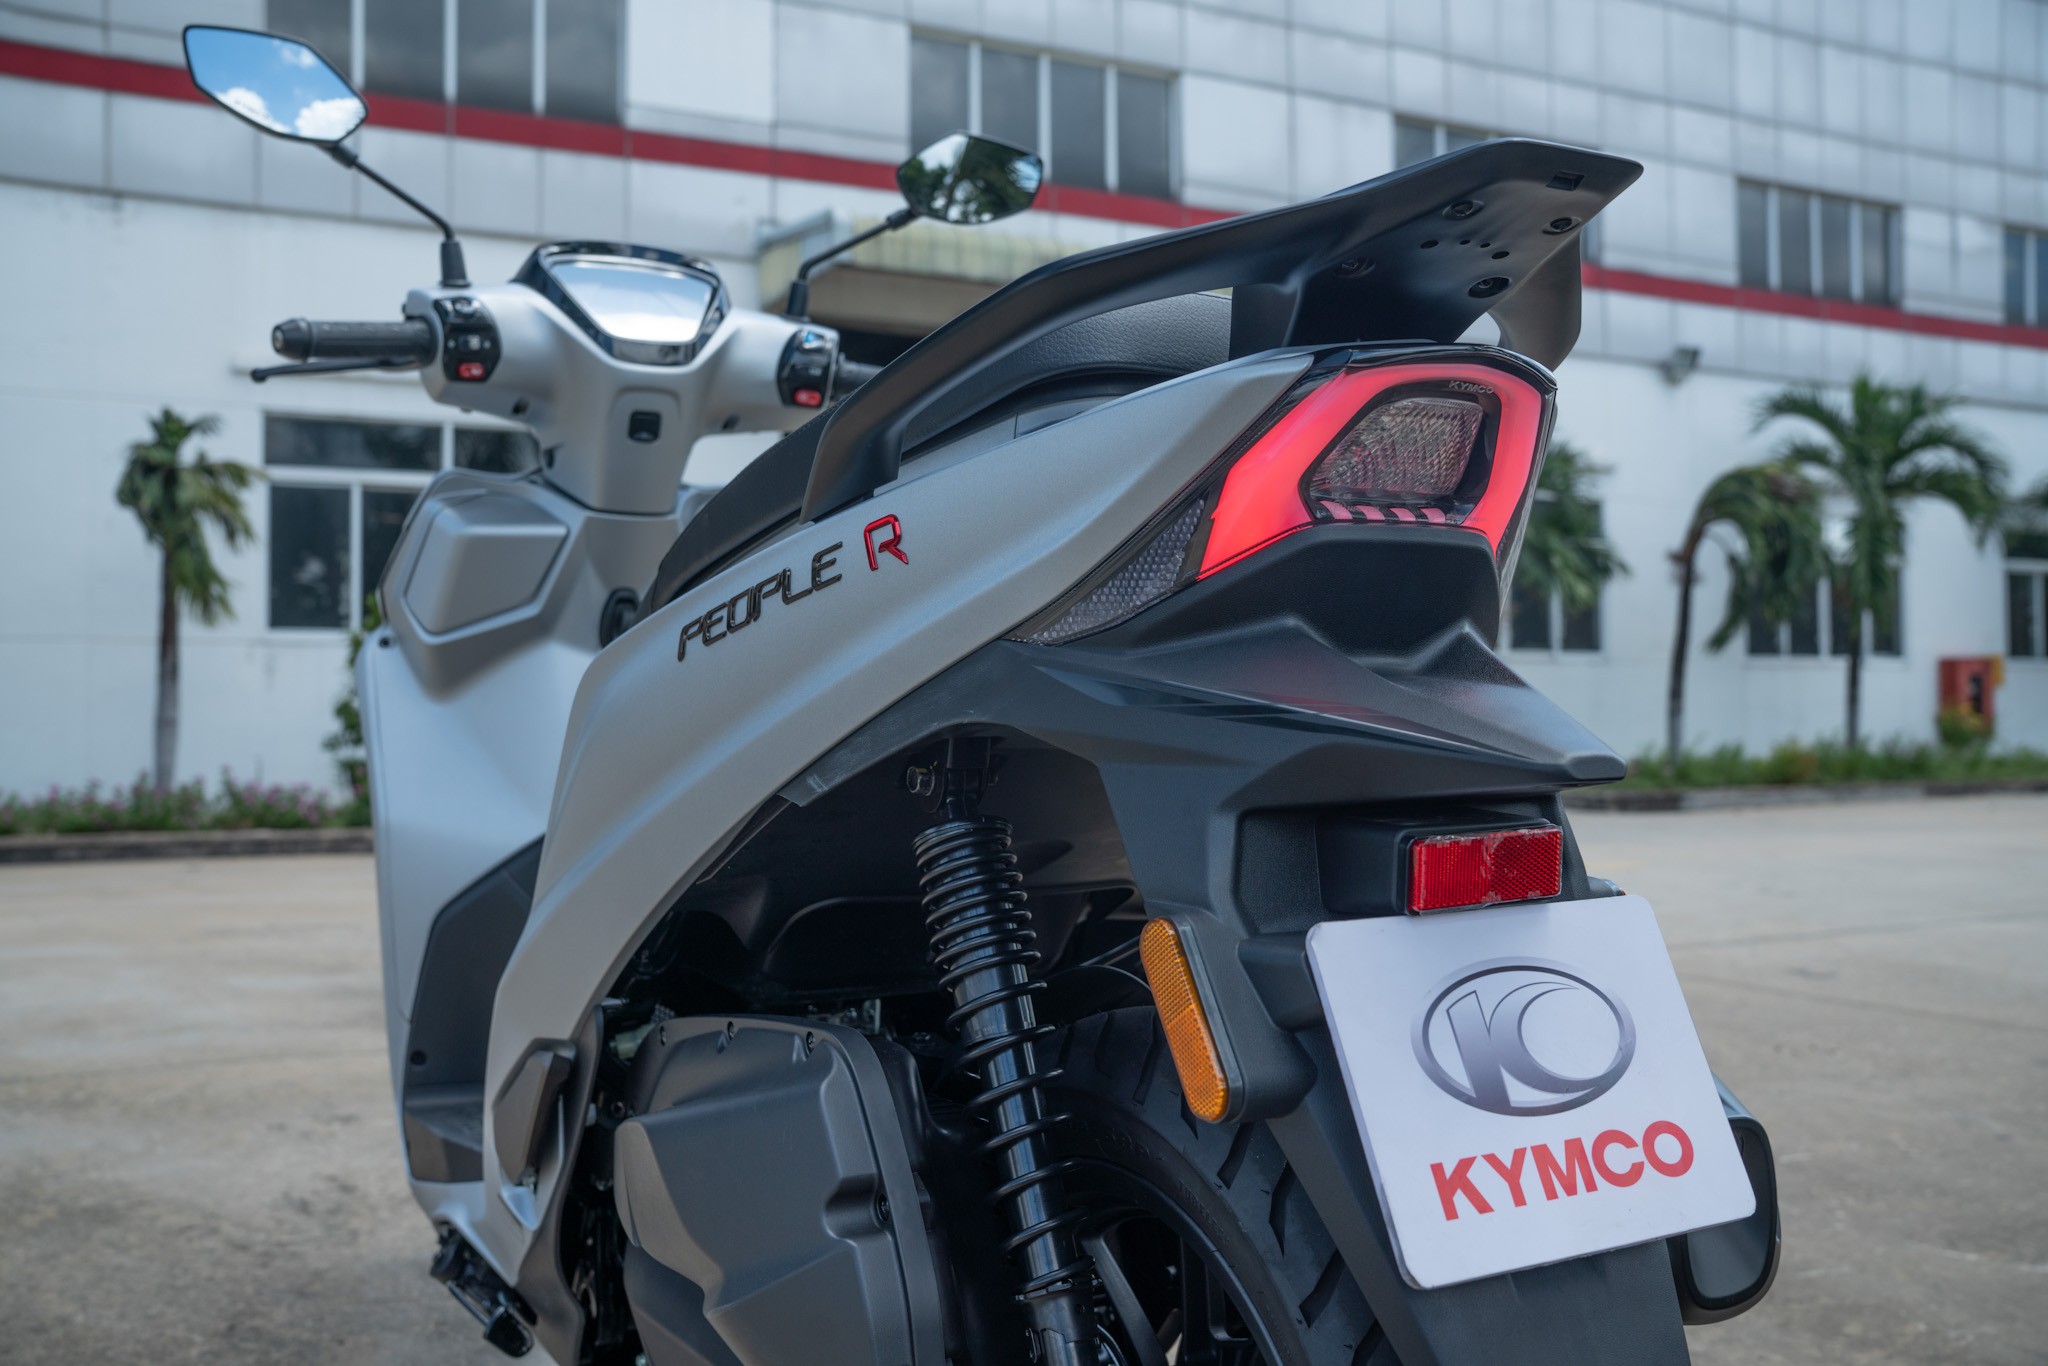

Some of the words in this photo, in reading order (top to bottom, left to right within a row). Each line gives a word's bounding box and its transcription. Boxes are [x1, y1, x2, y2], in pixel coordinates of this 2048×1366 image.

[1448, 380, 1495, 394] KYMCO
[677, 541, 843, 663] PEOPLE
[863, 513, 909, 572] R
[1430, 1120, 1694, 1221] KYMCO
